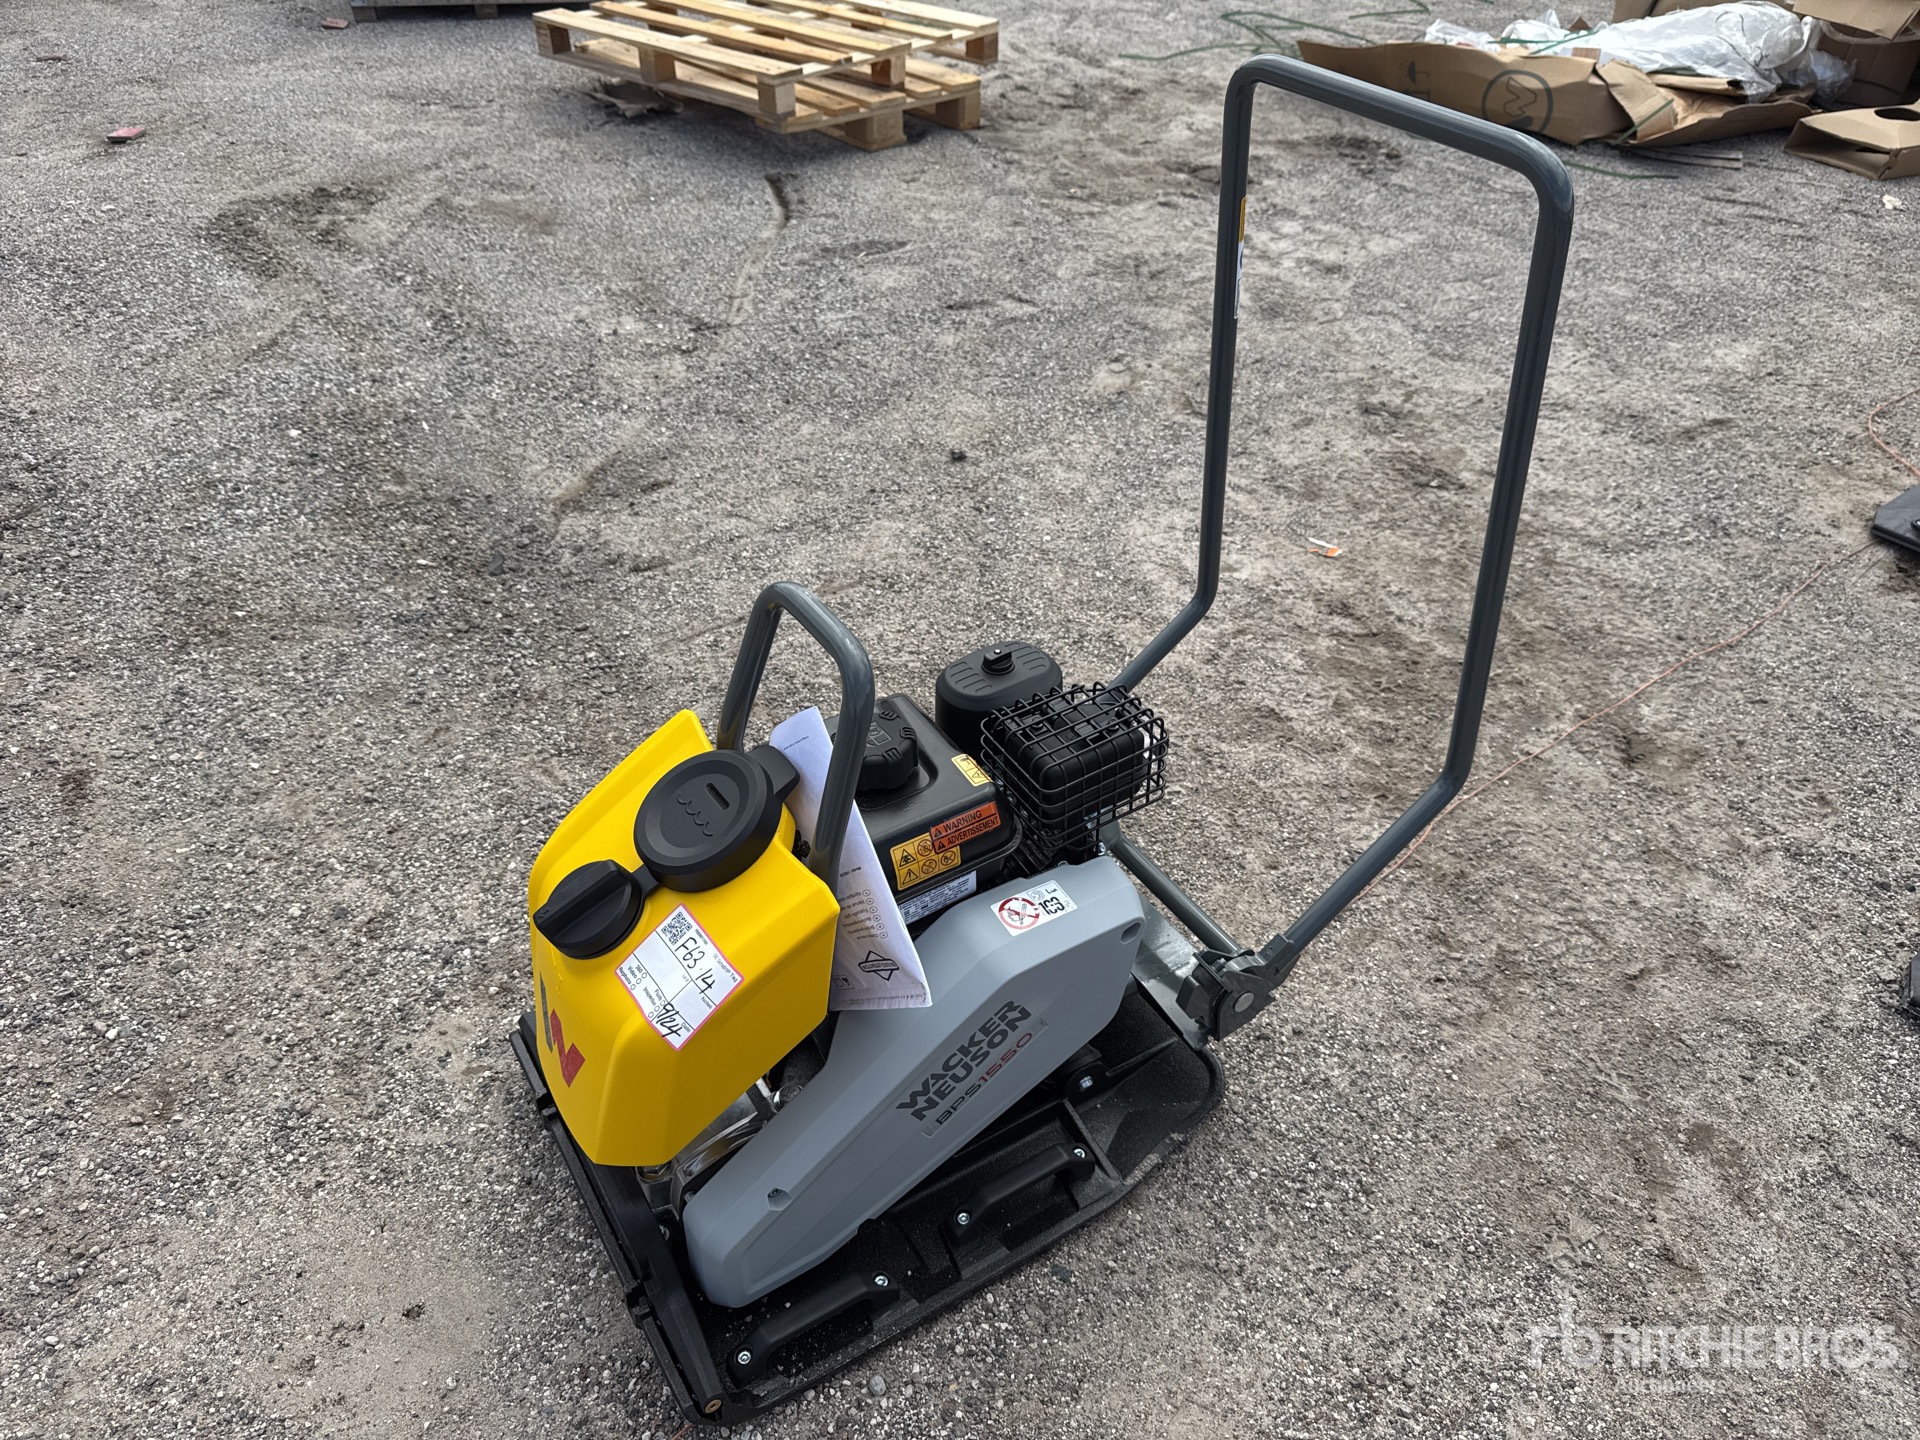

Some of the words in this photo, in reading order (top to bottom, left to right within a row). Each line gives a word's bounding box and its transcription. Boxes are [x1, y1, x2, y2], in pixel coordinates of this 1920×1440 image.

[942, 810, 982, 833] WARNING
[947, 816, 999, 846] ADVERTISSEMENT
[618, 967, 632, 985] Rephoto
[627, 964, 638, 979] Video
[700, 996, 713, 1010] Notes
[655, 1002, 683, 1038] 9/24
[681, 1021, 691, 1033] Date
[895, 1000, 1021, 1109] WACKER
[910, 1006, 1032, 1122] NEUSON
[935, 1032, 1033, 1125] BPS1550
